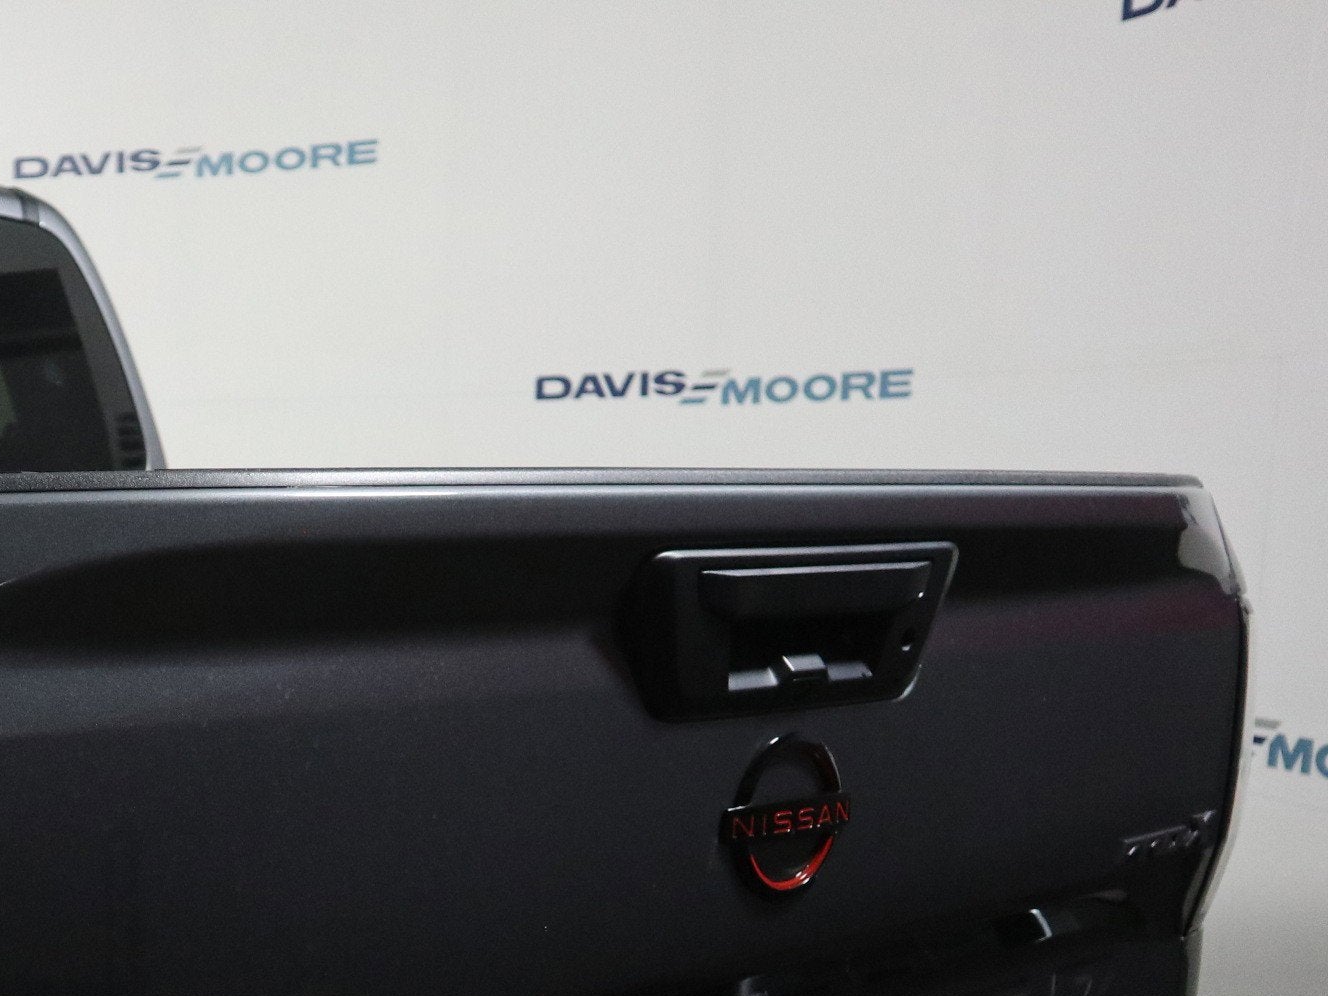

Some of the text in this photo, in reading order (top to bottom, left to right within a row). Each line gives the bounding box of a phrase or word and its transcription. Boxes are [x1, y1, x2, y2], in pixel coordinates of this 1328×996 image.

[13, 138, 380, 180] DAVIS MOORE
[535, 368, 914, 405] DAVIS MOORE
[730, 800, 851, 840] NISSAN
